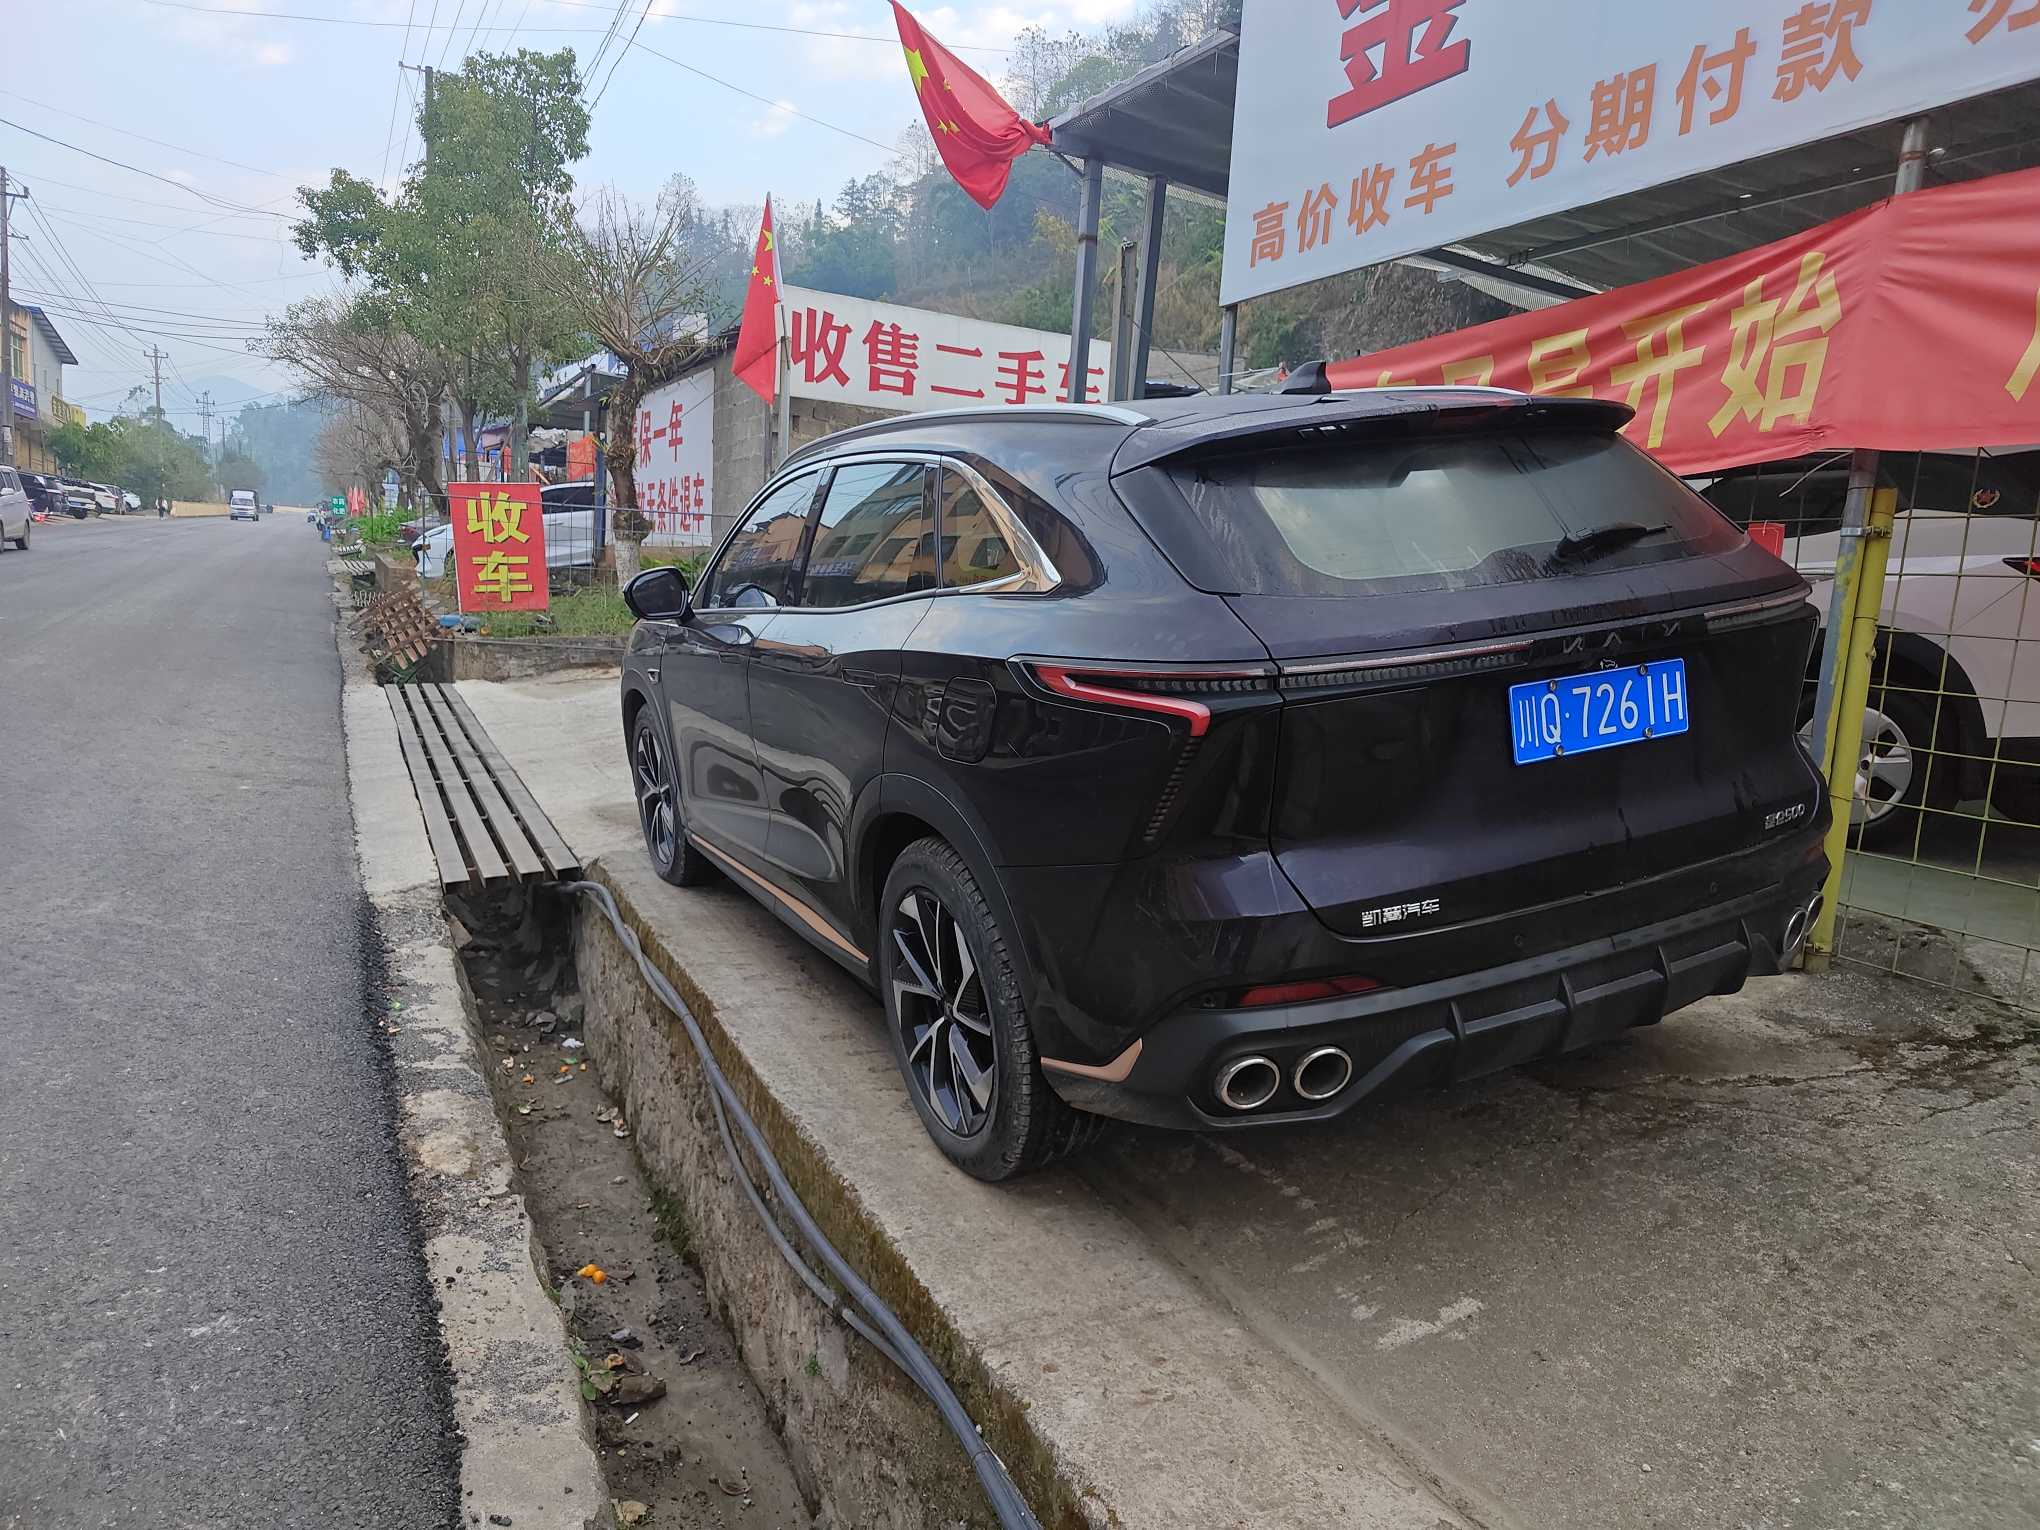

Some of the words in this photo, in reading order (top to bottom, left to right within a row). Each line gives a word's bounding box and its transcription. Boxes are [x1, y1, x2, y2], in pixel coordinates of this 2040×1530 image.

[1249, 142, 1457, 268] 高价收车
[1506, 0, 1873, 188] 分期付款
[632, 400, 683, 468] 保一年
[467, 492, 534, 602] 收车
